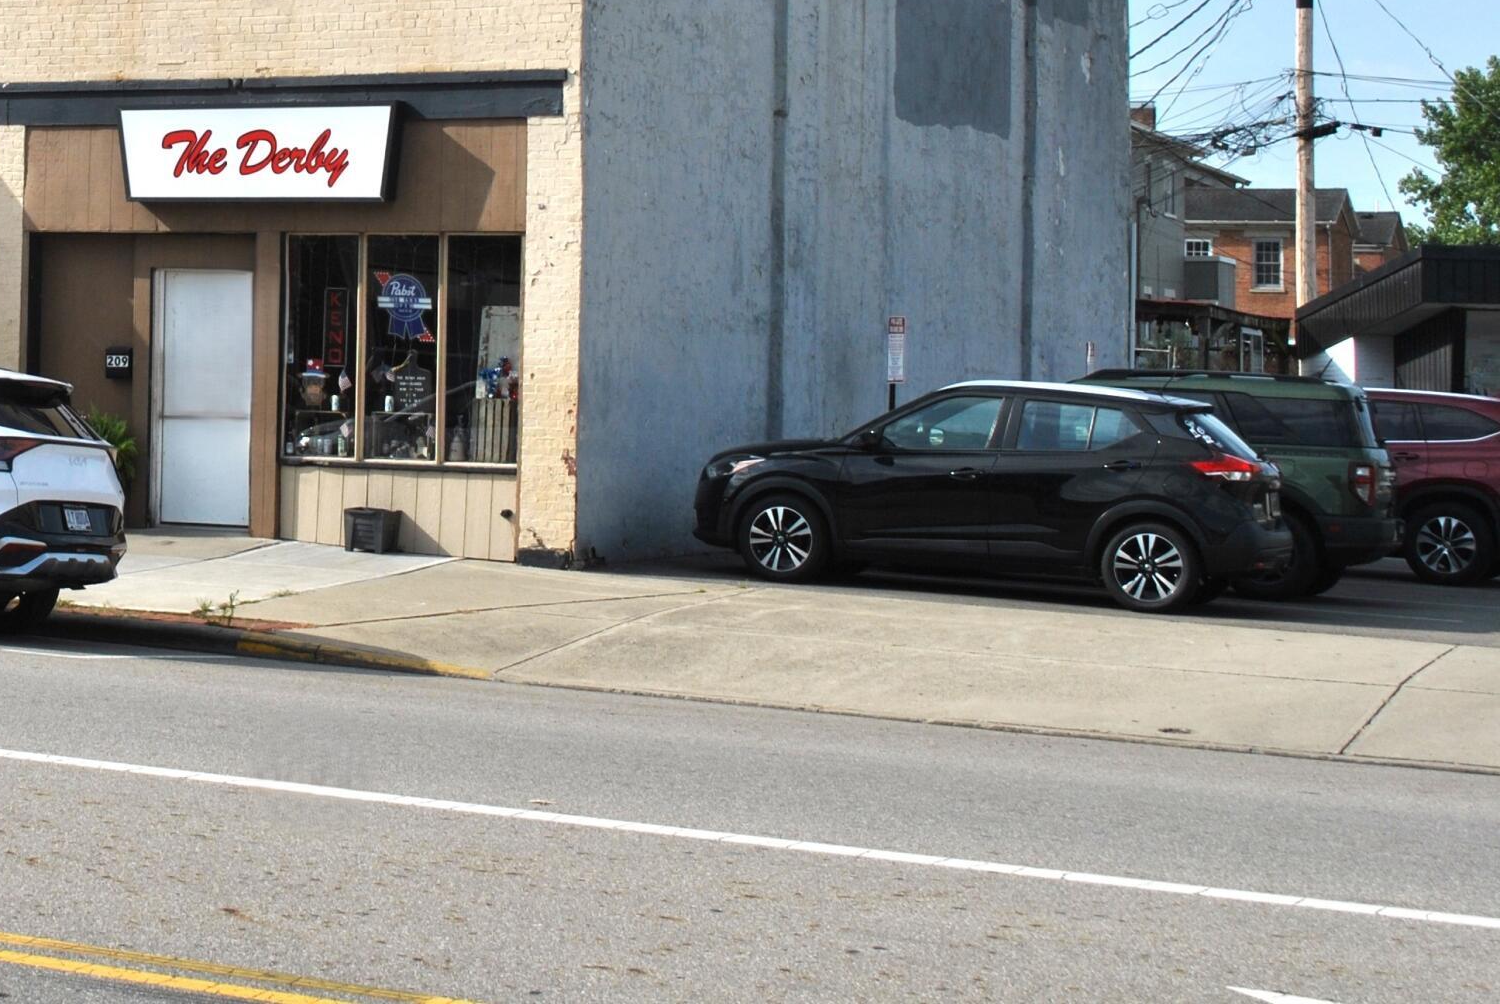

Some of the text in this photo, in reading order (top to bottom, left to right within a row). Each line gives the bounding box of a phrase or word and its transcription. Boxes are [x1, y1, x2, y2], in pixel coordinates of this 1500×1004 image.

[161, 128, 349, 188] The Derby
[390, 281, 416, 296] Pabst
[107, 356, 128, 367] 209
